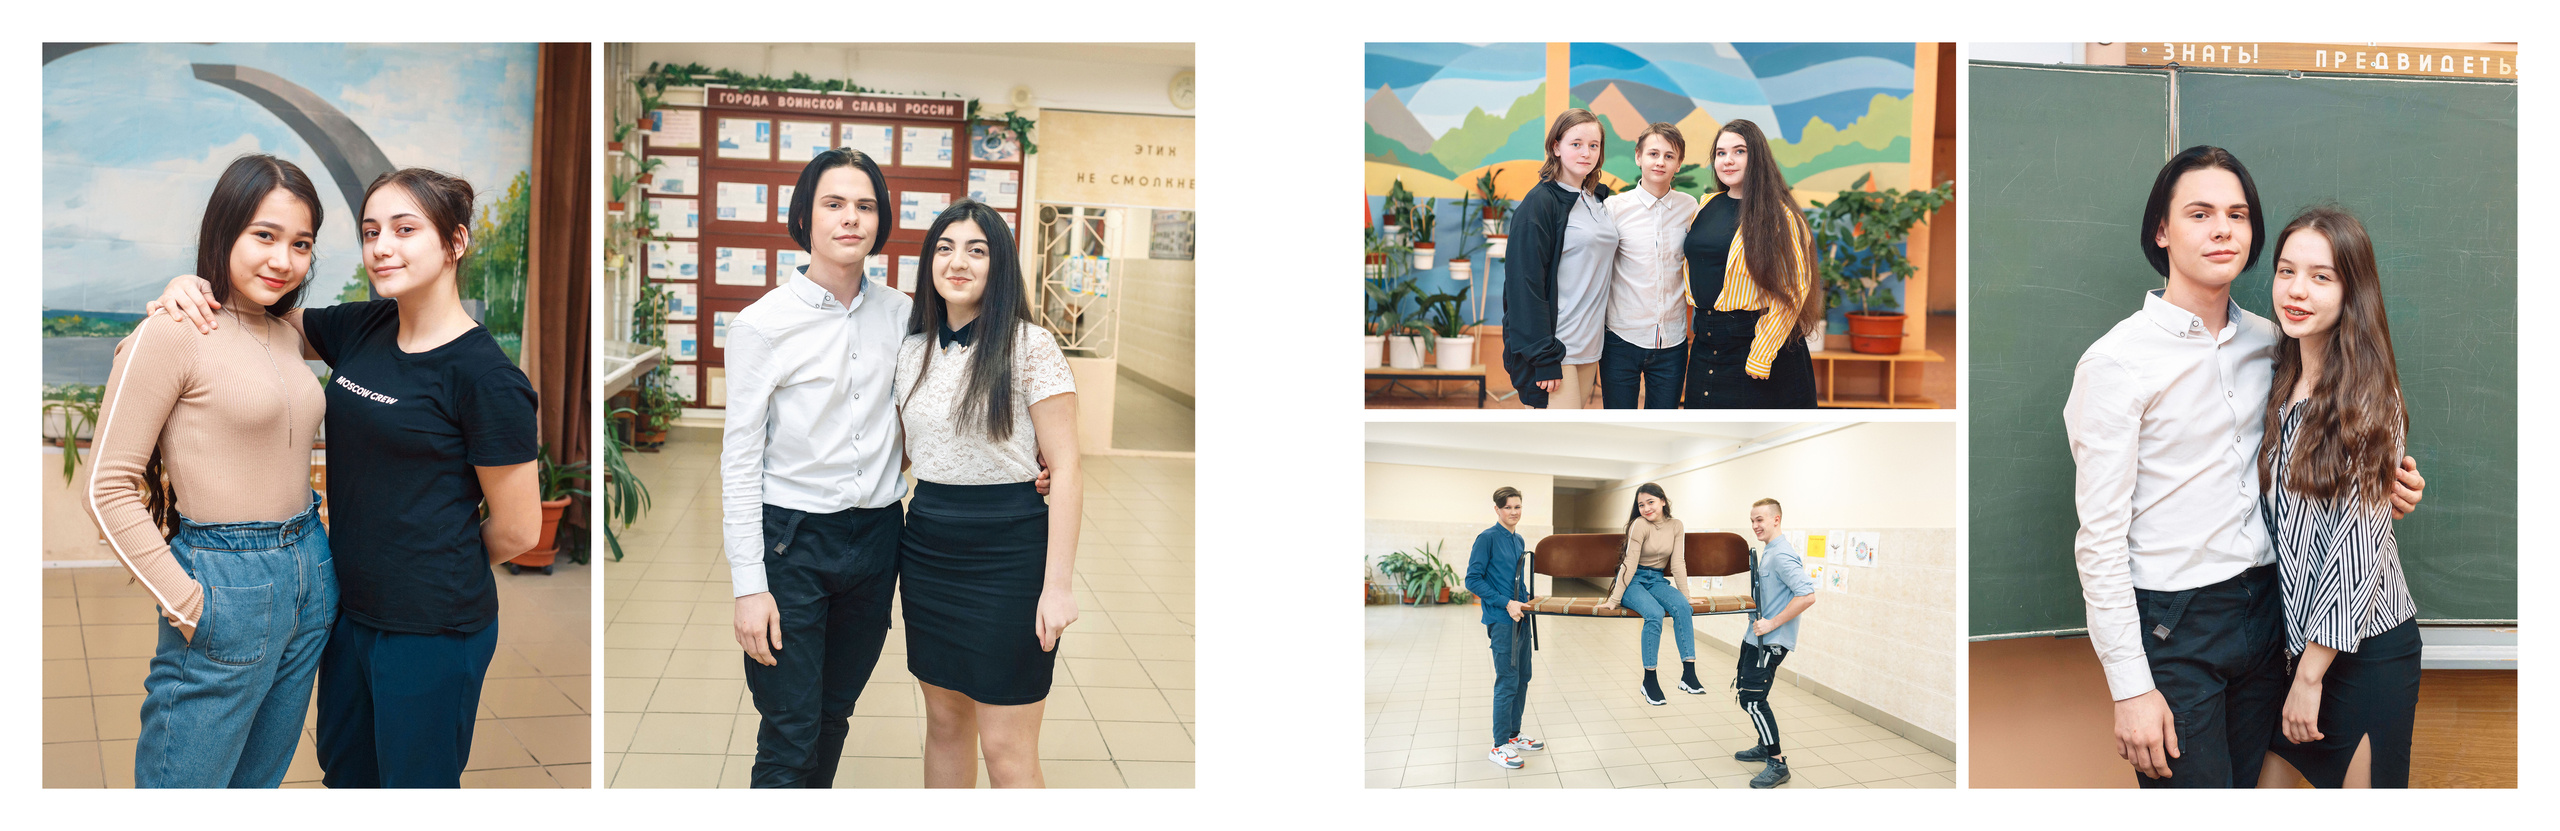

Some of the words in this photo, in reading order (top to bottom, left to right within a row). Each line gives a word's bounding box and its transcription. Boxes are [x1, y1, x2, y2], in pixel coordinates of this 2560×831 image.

[2163, 42, 2258, 64] ЗНАТЬ!
[719, 92, 769, 107] ГОРОДА
[778, 96, 843, 111] ВОИНСКОЙ
[852, 102, 896, 113] СЛАВЫ
[905, 103, 954, 116] РОССИИ
[1077, 172, 1096, 184] НЕ
[1110, 174, 1195, 190] СМОЛКНЕ
[335, 375, 373, 398] MOSCOW
[369, 392, 399, 405] CREW
